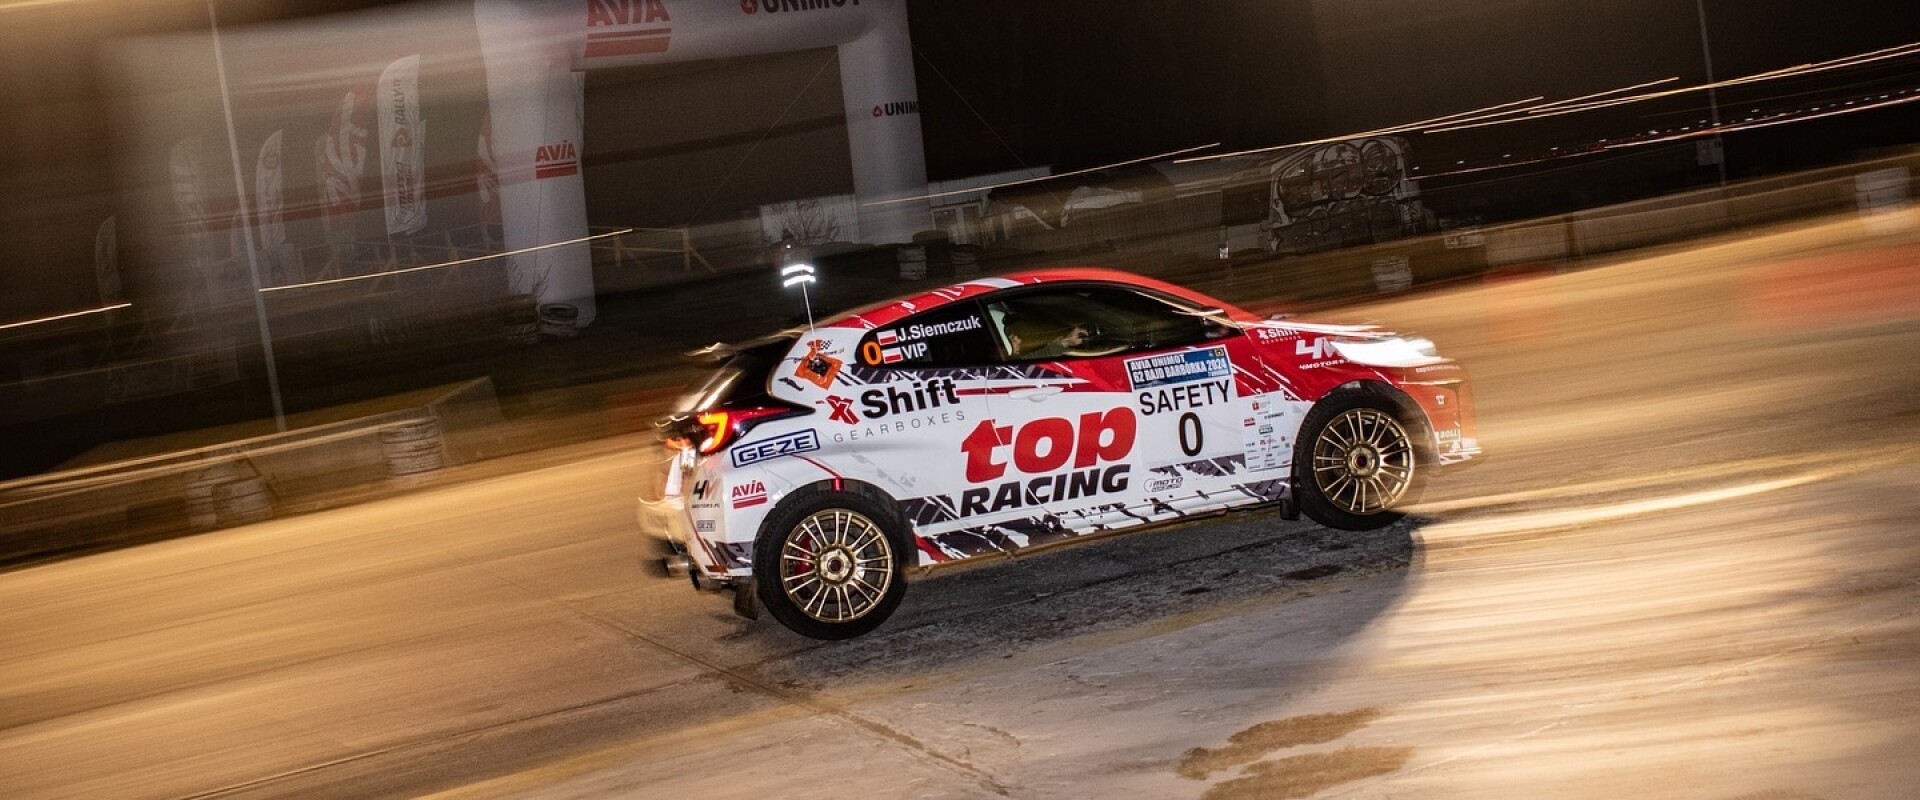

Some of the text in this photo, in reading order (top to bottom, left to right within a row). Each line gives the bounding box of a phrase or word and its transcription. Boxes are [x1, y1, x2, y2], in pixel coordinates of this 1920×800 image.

[587, 0, 671, 26] AVIA
[763, 0, 861, 13] UNI
[884, 101, 919, 116] UNIM
[863, 315, 982, 366] 0 J.Siemczuk
[901, 342, 928, 361] VIP
[1132, 371, 1145, 383] 62
[1206, 358, 1227, 372] 2024
[860, 378, 961, 419] Shift
[1140, 380, 1230, 416] SAFETY
[833, 410, 966, 444] GEARBOXES
[1178, 411, 1204, 457] 0
[738, 435, 813, 462] GEZE
[961, 407, 1137, 483] top
[960, 464, 1131, 517] RACING
